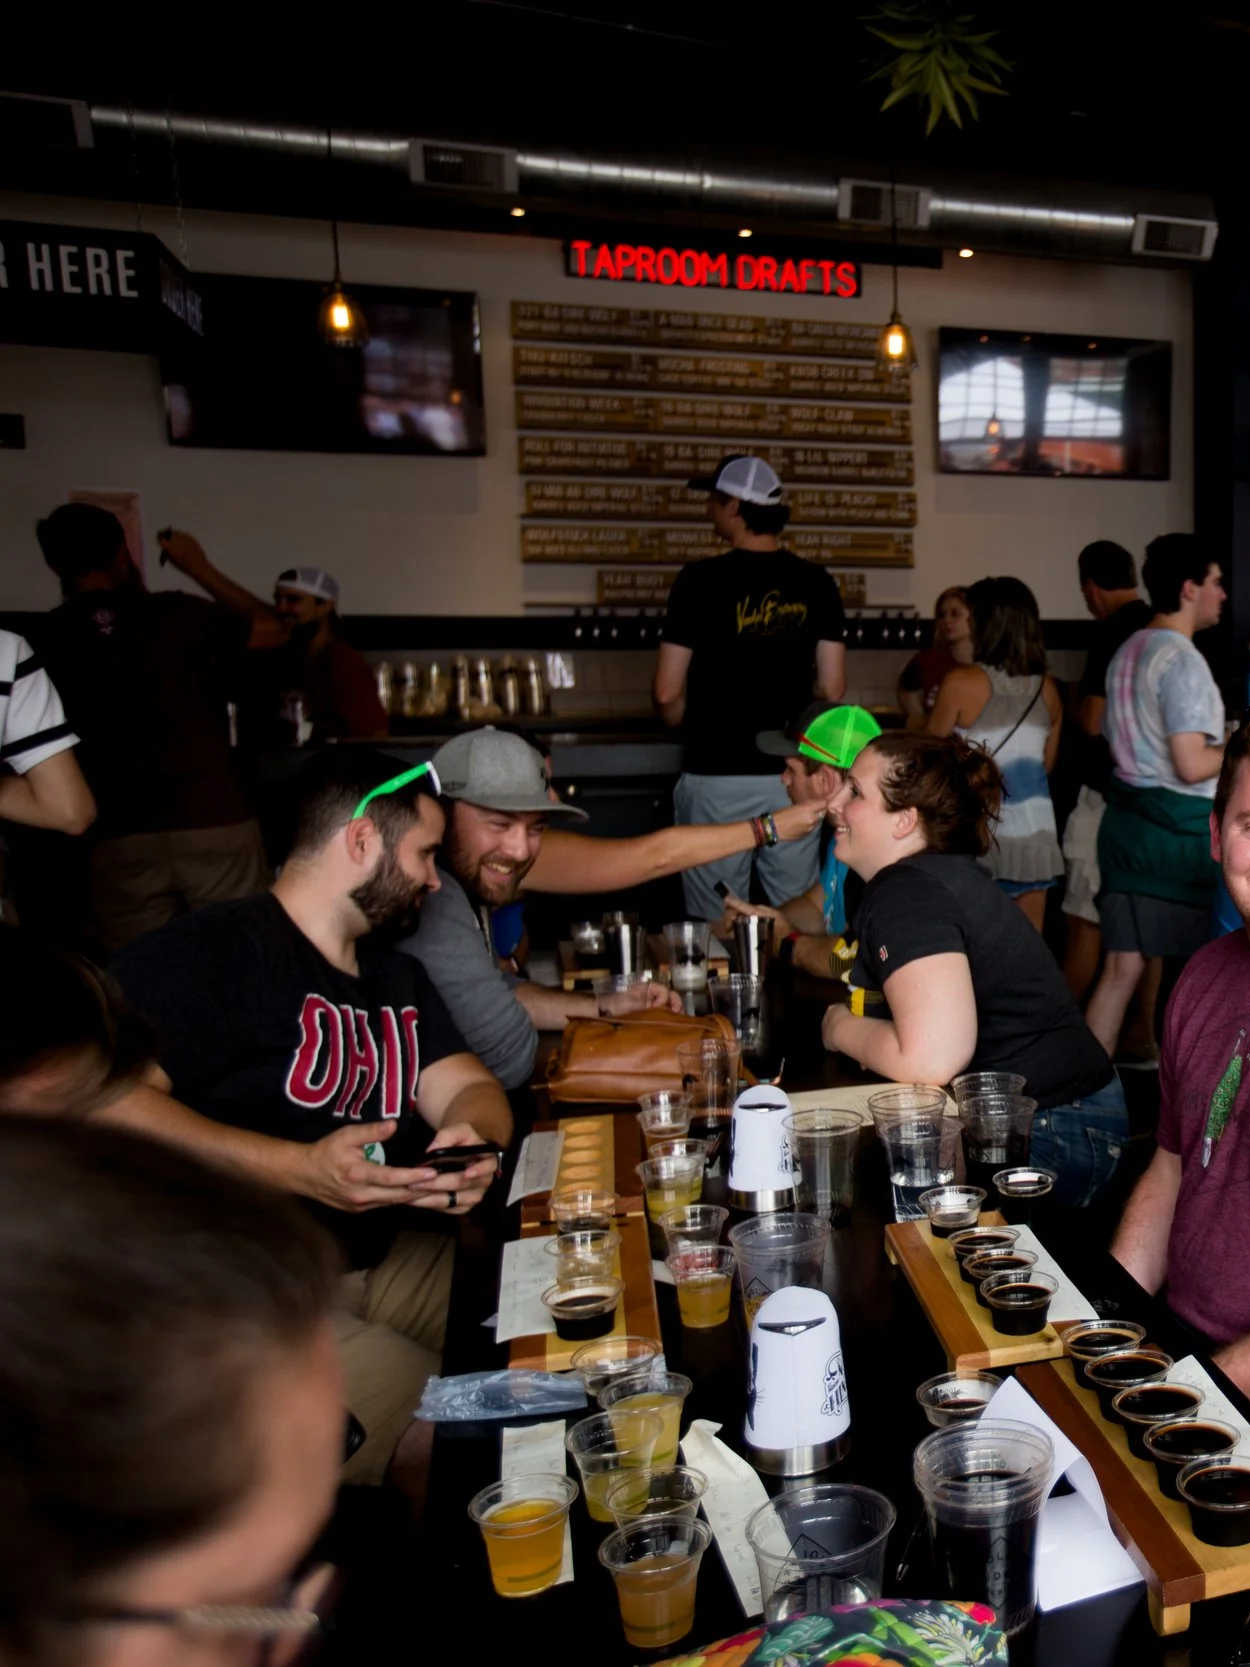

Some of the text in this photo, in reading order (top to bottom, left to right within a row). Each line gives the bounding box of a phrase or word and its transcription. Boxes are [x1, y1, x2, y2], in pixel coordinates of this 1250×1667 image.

[26, 242, 139, 298] HERE
[572, 240, 857, 297] TAPROOM DRAFTS
